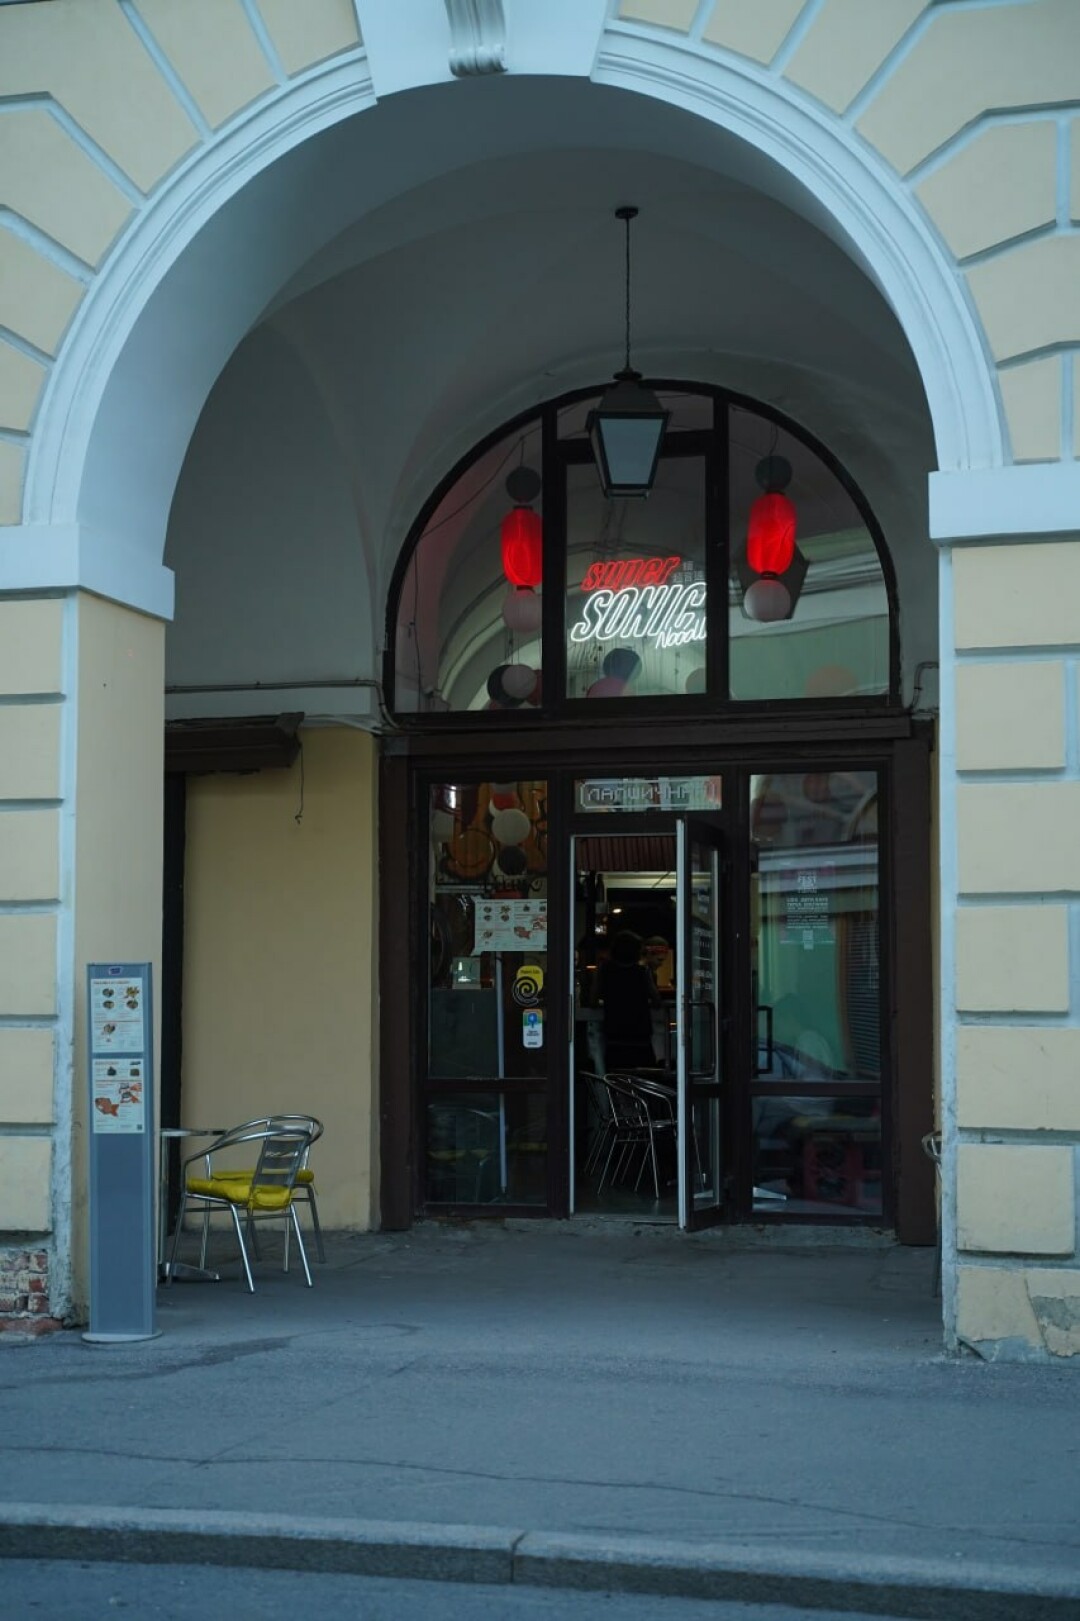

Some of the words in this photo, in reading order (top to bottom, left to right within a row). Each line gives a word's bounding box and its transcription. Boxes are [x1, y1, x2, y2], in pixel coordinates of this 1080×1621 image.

[580, 556, 682, 591] super
[570, 582, 707, 642] SONIC
[587, 784, 698, 802] ЛАПШИЧНА
